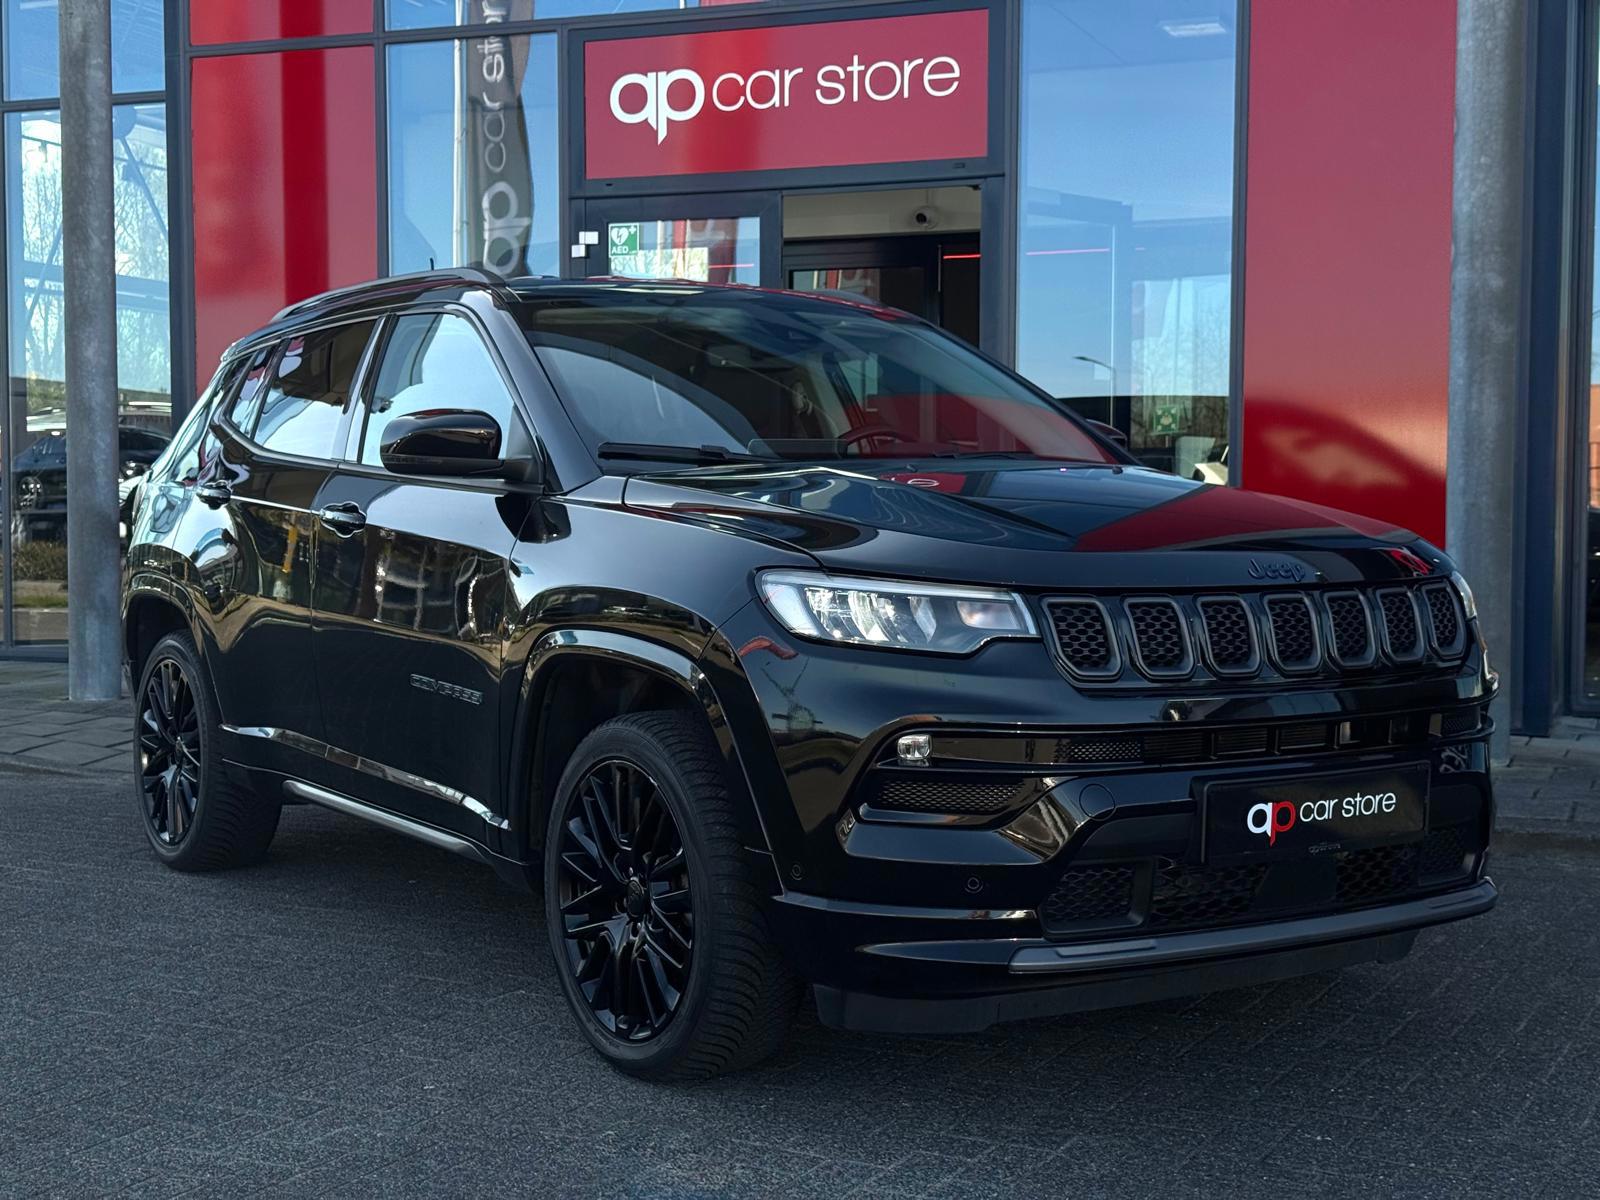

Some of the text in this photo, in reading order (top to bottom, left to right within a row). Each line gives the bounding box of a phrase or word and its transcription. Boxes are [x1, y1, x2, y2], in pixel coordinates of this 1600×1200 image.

[482, 91, 506, 173] car
[609, 54, 961, 146] ap car store
[482, 181, 531, 275] ap
[611, 246, 629, 254] AED
[1248, 558, 1306, 582] Jeep
[1246, 792, 1397, 847] ap car store
